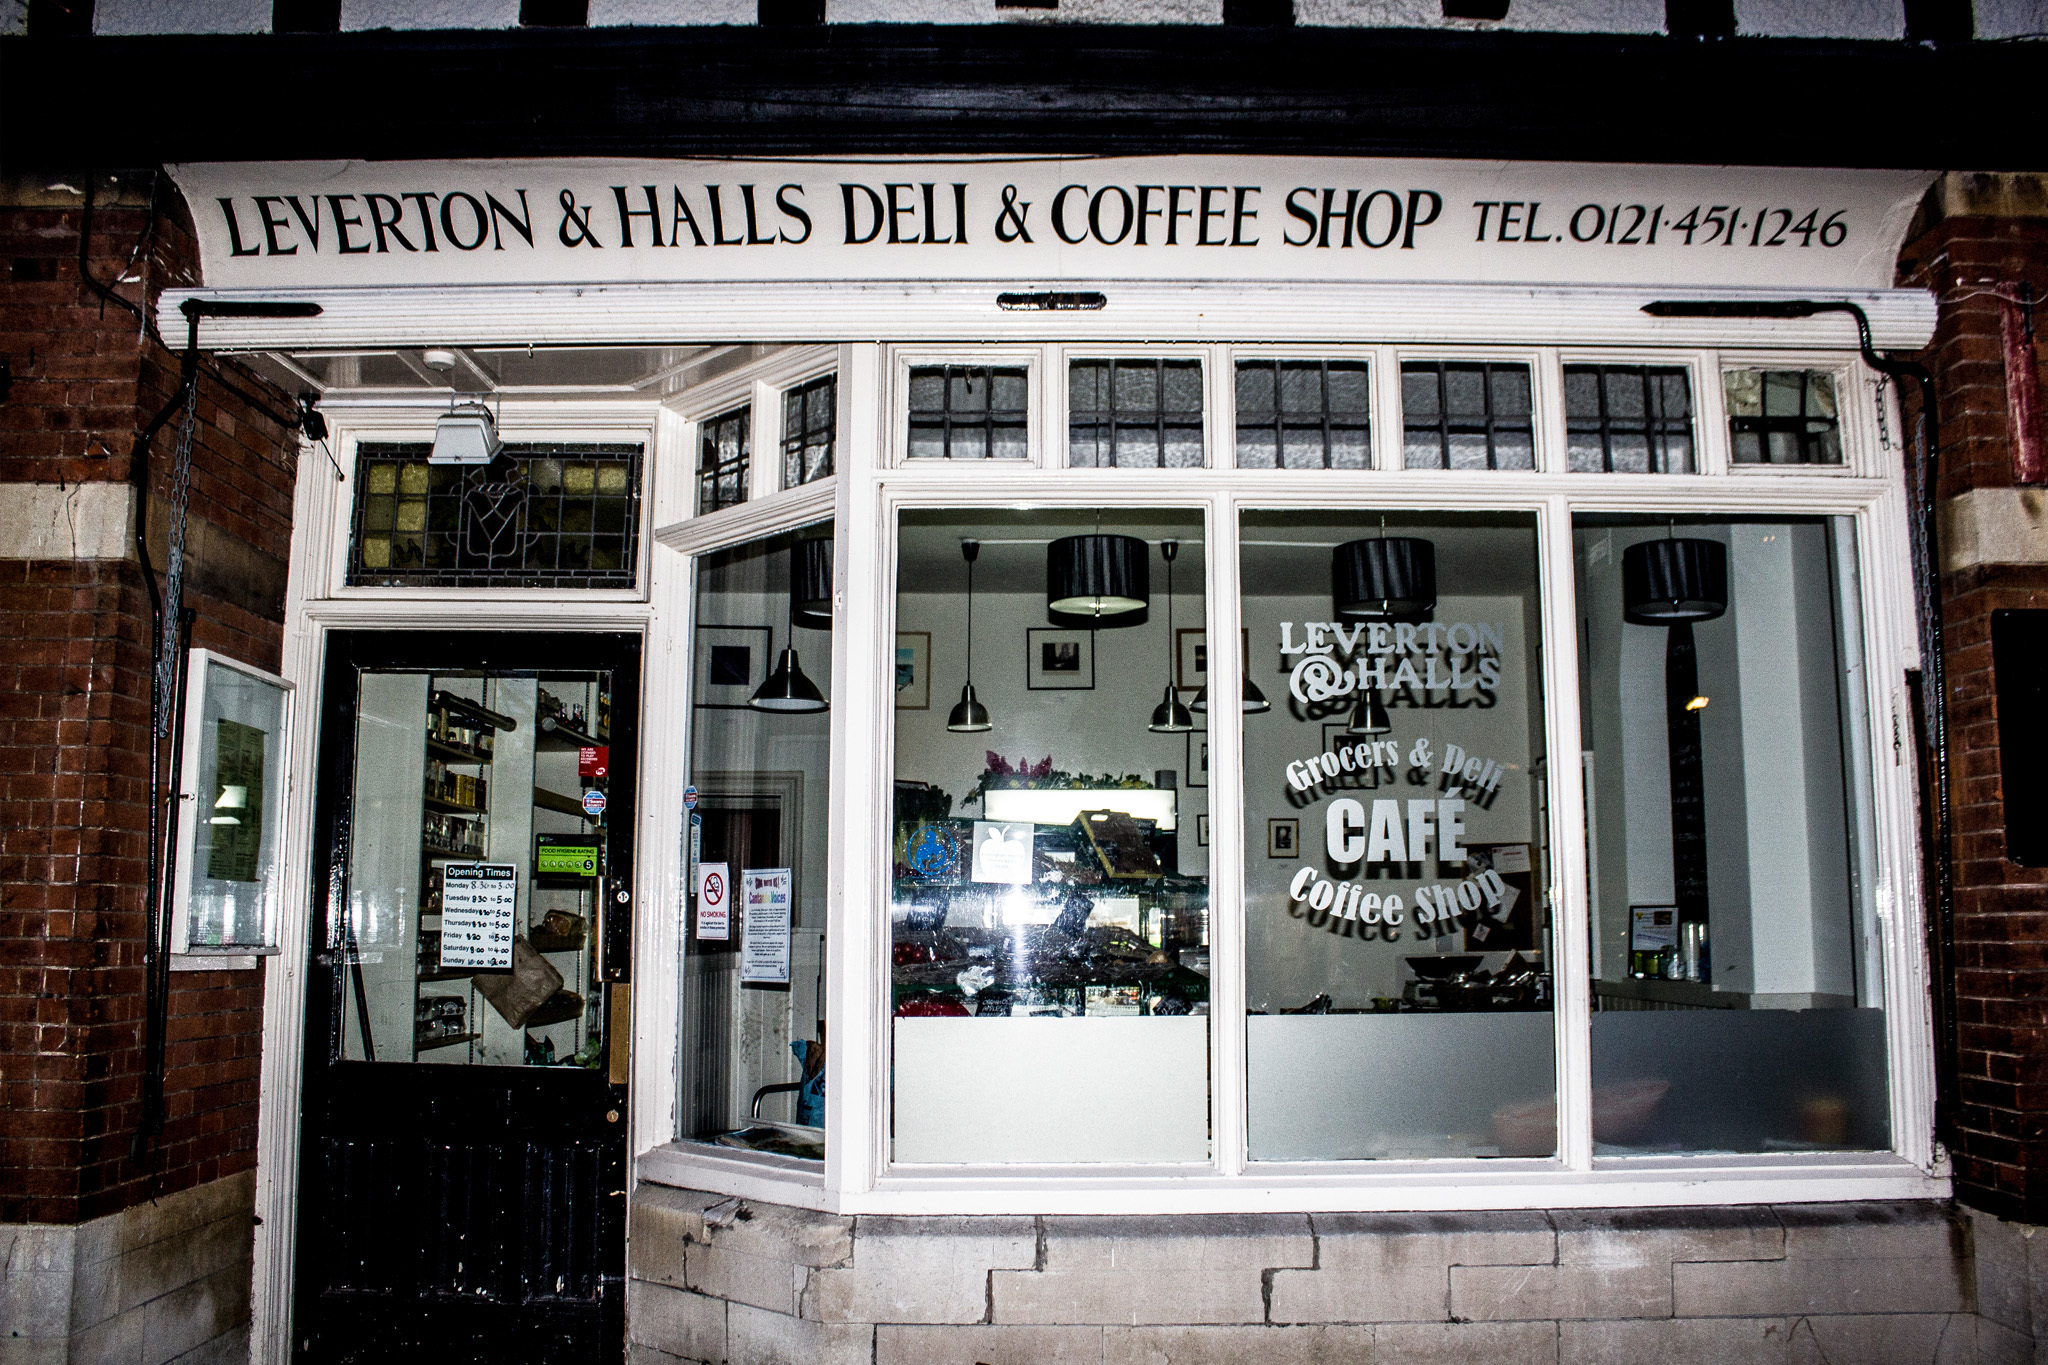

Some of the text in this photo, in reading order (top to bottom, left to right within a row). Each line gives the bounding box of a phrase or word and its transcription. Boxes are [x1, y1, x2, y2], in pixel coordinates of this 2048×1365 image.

[216, 189, 534, 257] LEVERTON
[559, 188, 603, 248] &
[610, 184, 813, 248] HALLS
[842, 184, 968, 245] DELI
[995, 185, 1034, 243] &
[1051, 185, 1262, 247] COFFEE
[1284, 187, 1443, 250] SHOP
[1279, 621, 1503, 655] LEVERTON
[1356, 656, 1502, 690] HALLS
[1286, 737, 1504, 793] Grocers & Deli
[1326, 787, 1468, 864] CAFÉ
[448, 867, 511, 878] Opening Times
[445, 894, 471, 902] Tuesday
[1289, 866, 1506, 926] Coffee Shop
[444, 907, 479, 915] Wednesday
[444, 919, 472, 927] Thursday
[443, 931, 462, 939] Friday
[443, 944, 469, 952] Saturday
